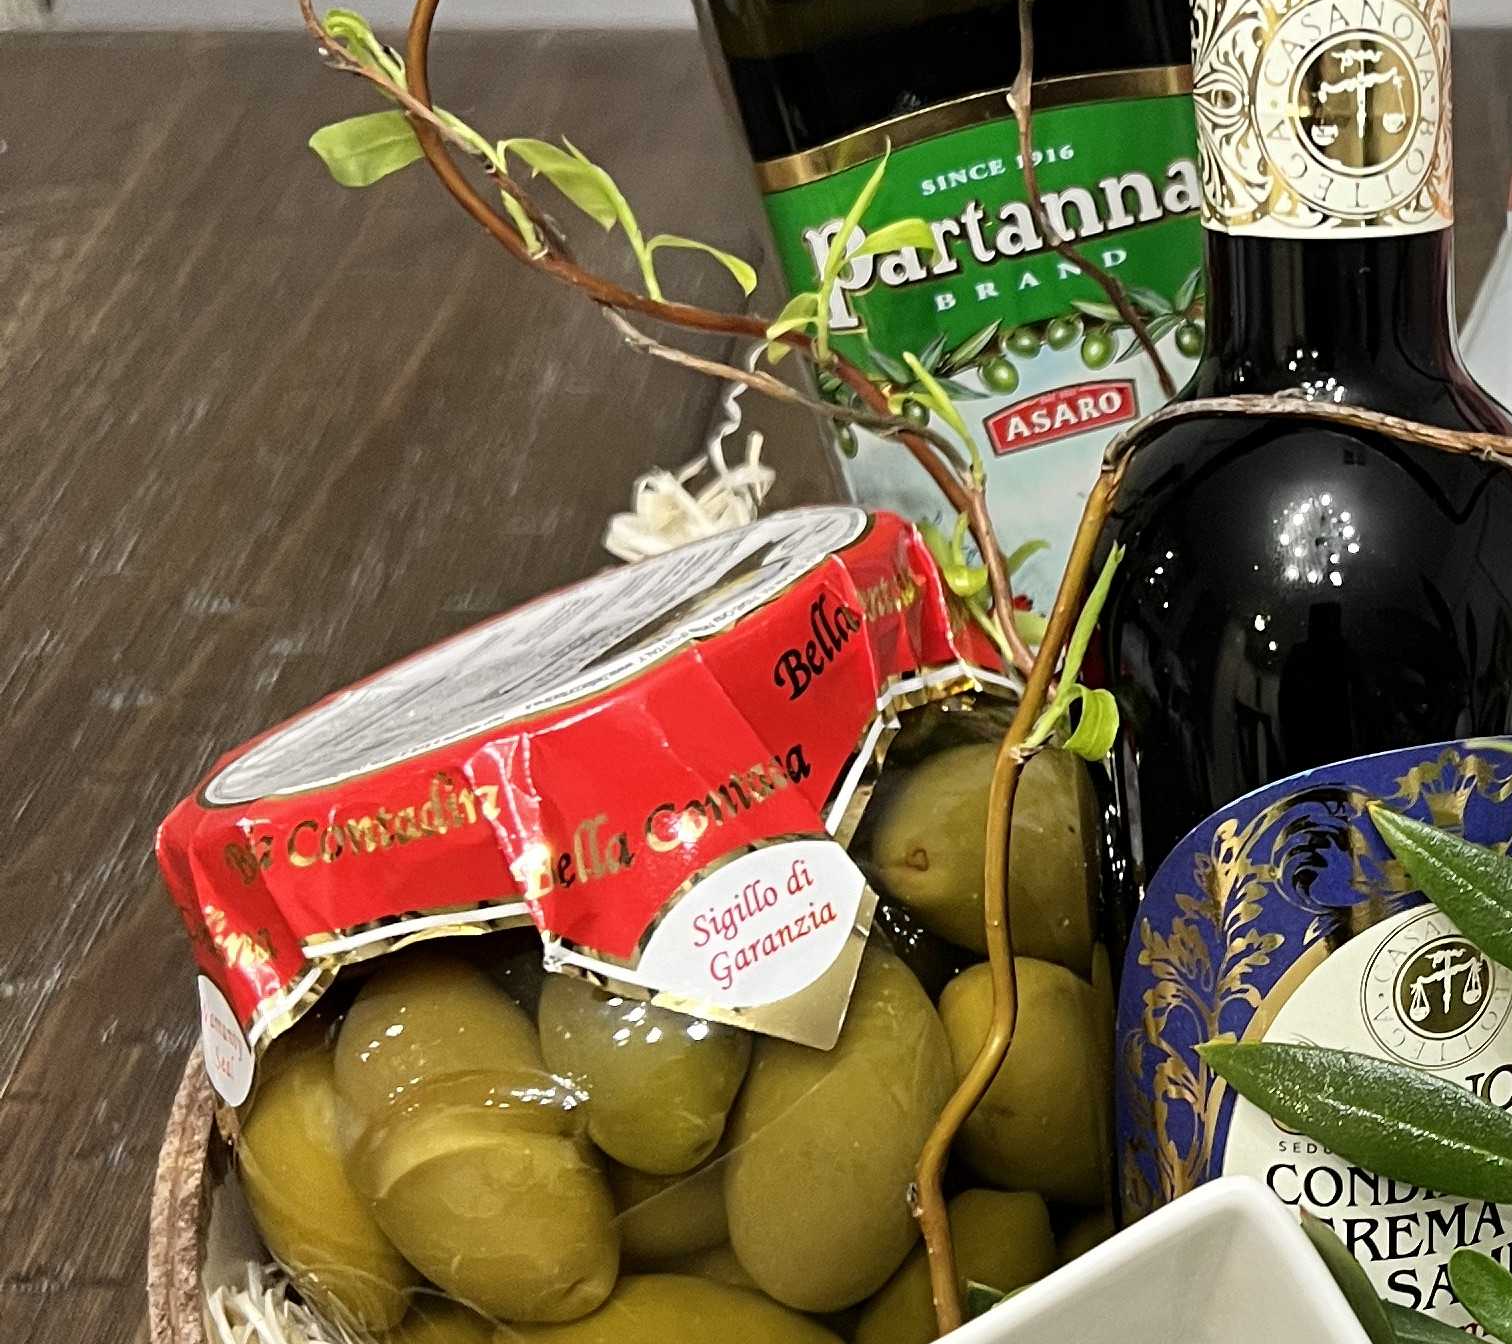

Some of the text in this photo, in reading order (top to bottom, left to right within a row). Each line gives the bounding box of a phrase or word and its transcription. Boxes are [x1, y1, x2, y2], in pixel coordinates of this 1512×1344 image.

[920, 158, 1007, 197] SINCE
[934, 248, 1128, 313] BRAND
[1005, 389, 1123, 443] ASARO
[773, 592, 862, 701] Bella
[691, 857, 816, 948] Sigillo di
[708, 898, 838, 991] Garanzia
